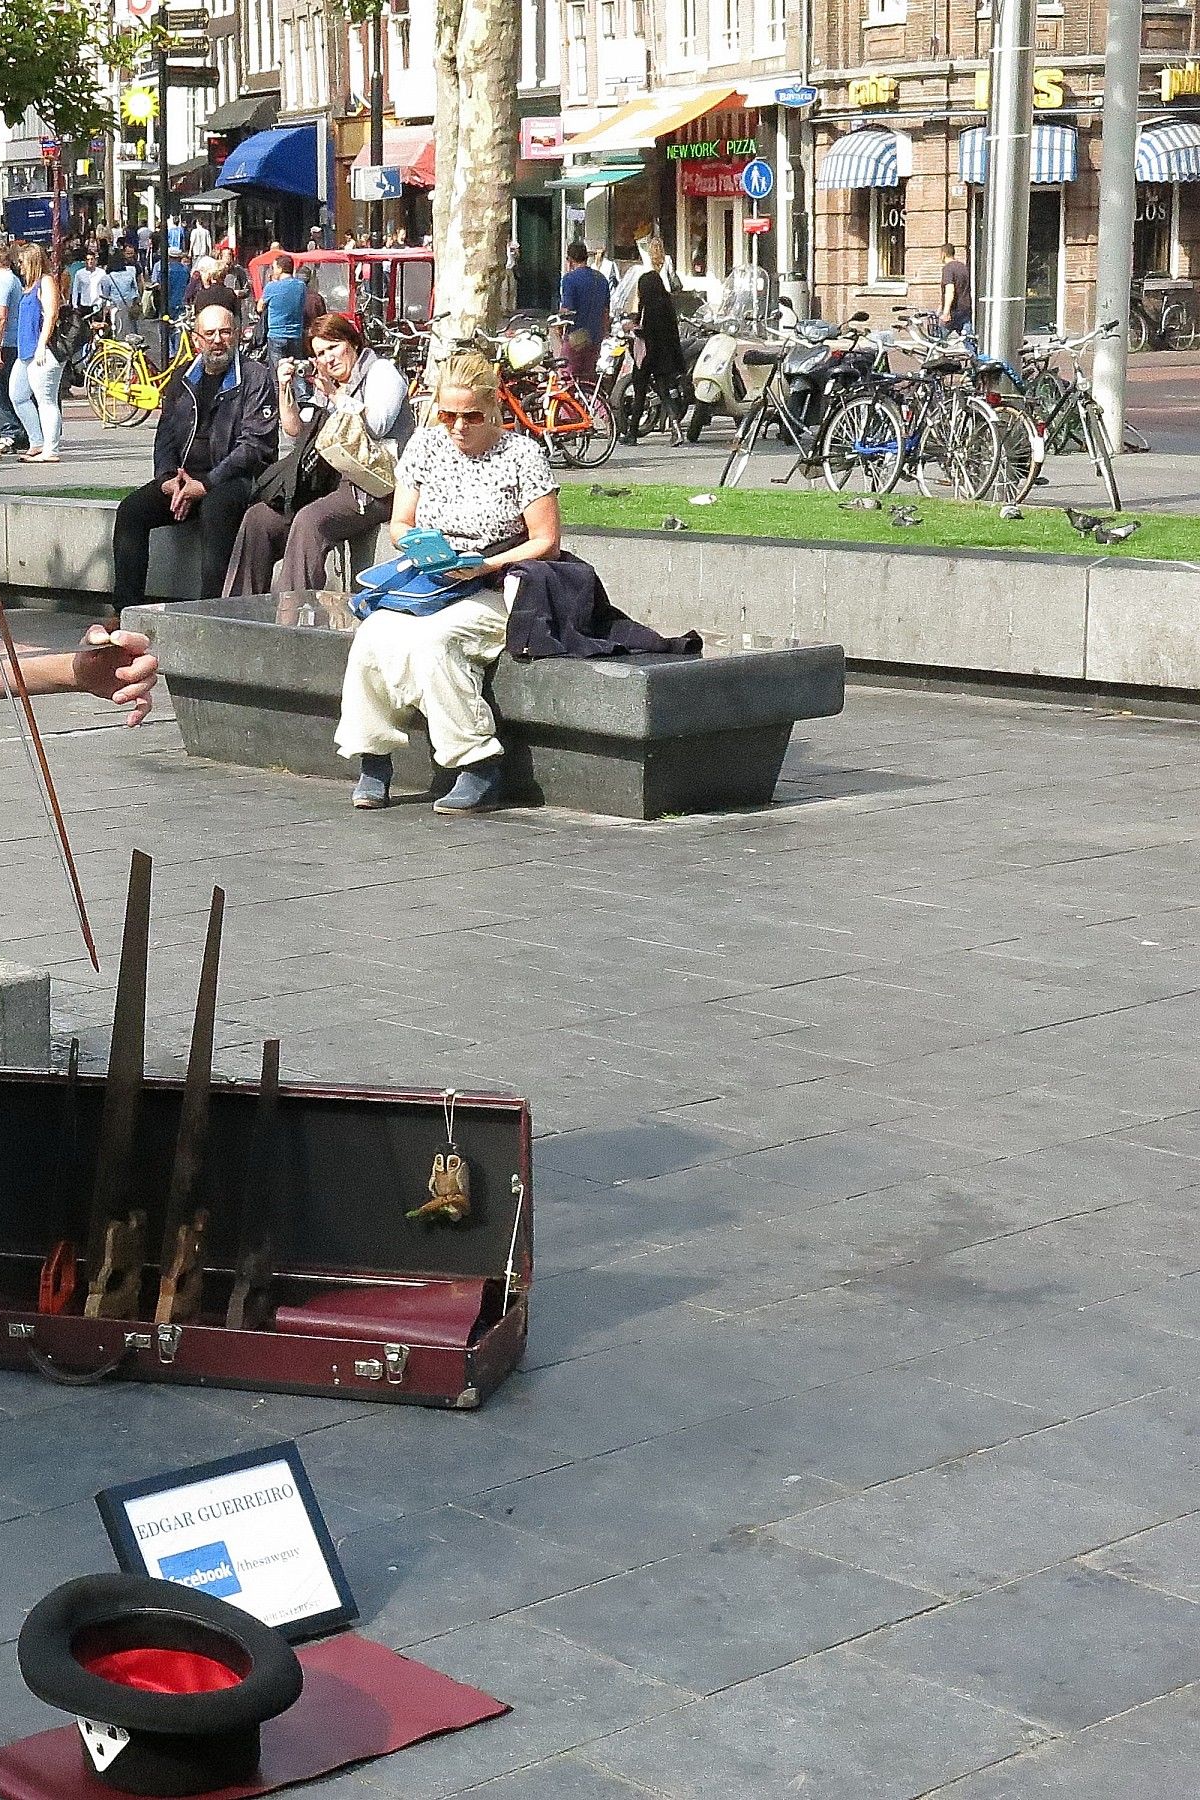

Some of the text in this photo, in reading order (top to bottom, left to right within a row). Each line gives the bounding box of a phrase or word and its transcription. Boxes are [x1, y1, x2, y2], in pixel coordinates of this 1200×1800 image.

[779, 91, 813, 101] Bavaria
[666, 138, 757, 160] NEW YORK PIZZA
[136, 1483, 294, 1540] EDGAR GUERREIRO
[236, 1547, 300, 1572] /thesawguy
